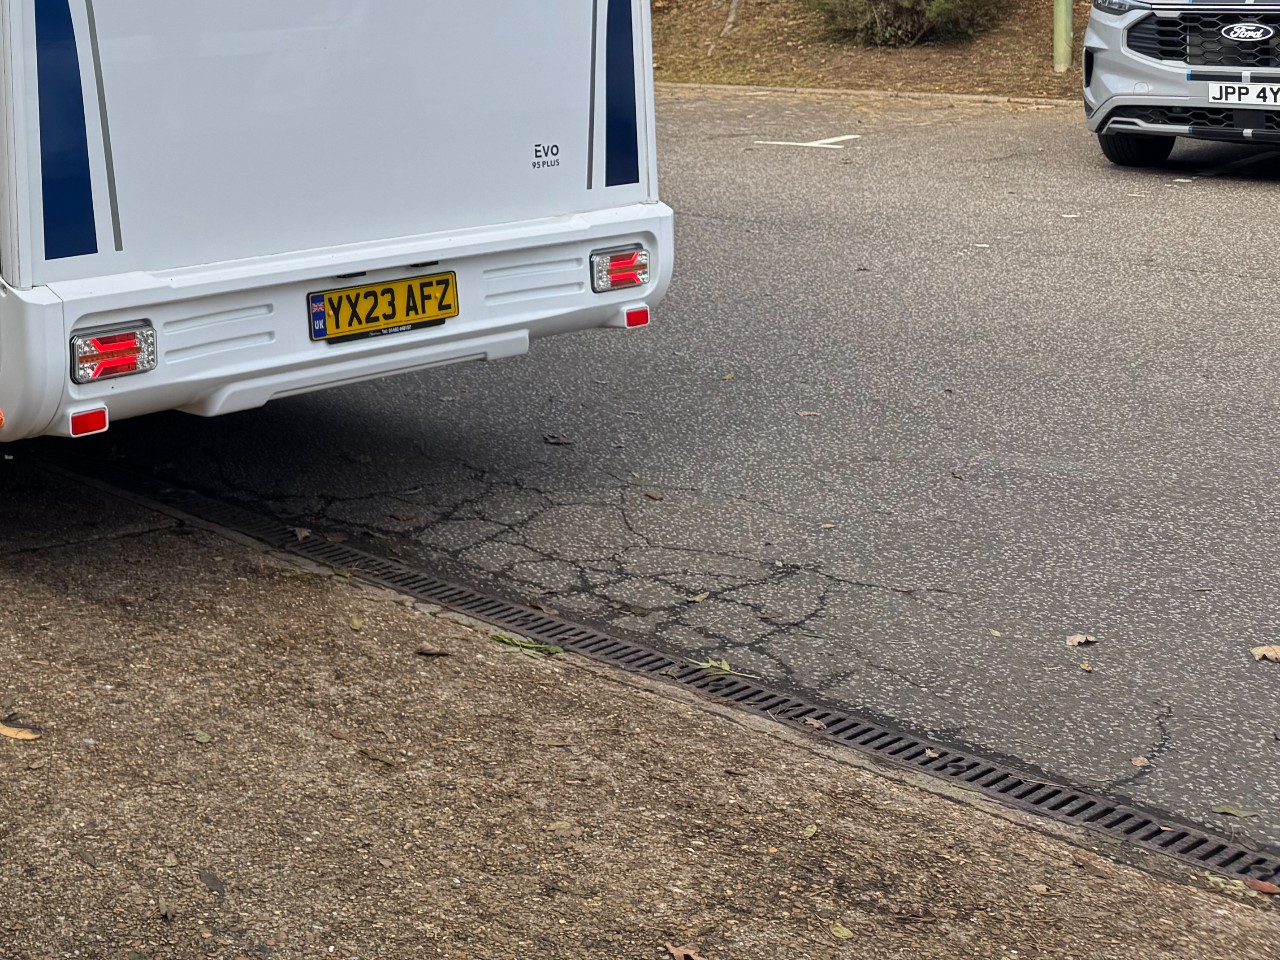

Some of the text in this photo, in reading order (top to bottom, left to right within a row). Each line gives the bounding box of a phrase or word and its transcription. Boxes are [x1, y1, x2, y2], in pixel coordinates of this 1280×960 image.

[1229, 25, 1264, 39] Ford
[1211, 85, 1280, 103] JPP 4Y
[531, 158, 560, 169] 95 PLUS
[327, 287, 397, 330] YX23
[405, 278, 452, 318] AFZ
[314, 319, 325, 330] UK
